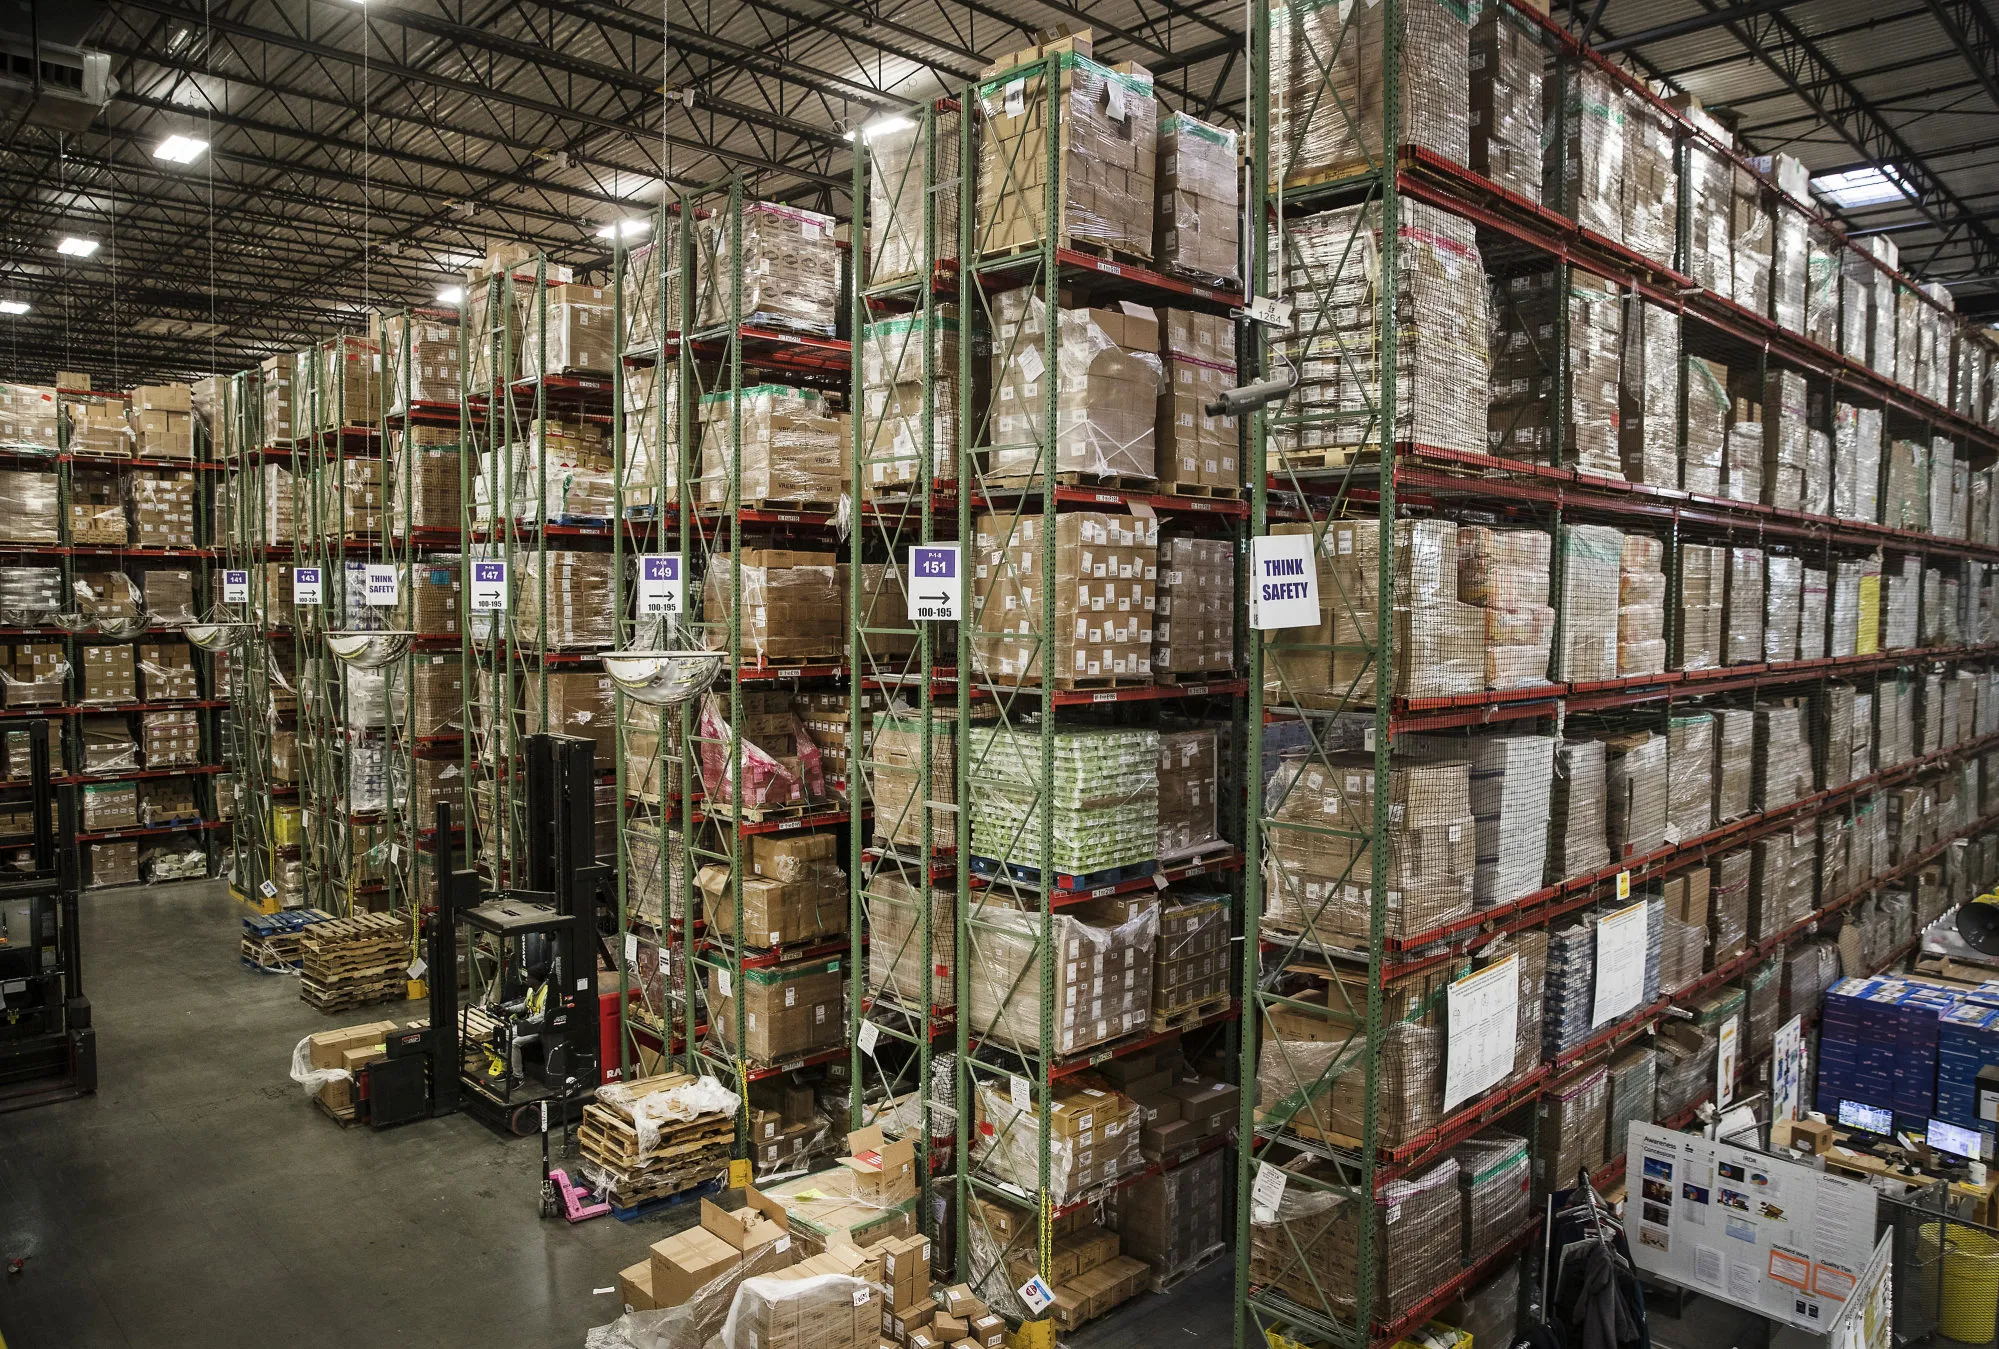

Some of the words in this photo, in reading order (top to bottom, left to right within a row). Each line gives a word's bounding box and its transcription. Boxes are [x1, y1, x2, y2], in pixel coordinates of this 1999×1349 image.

[1258, 311, 1281, 324] 1264
[652, 566, 672, 578] 149
[923, 560, 946, 574] 151
[1264, 558, 1304, 577] THINK
[301, 574, 315, 582] 143
[370, 575, 393, 583] THINK
[481, 571, 499, 580] 147
[369, 585, 395, 593] SAFETY
[1262, 581, 1308, 601] SAFETY
[478, 600, 502, 608] 100-195
[648, 603, 676, 612] 100-195
[917, 607, 952, 617] 100-195
[1822, 1175, 1849, 1187] Customer
[1820, 1259, 1840, 1270] Quality
